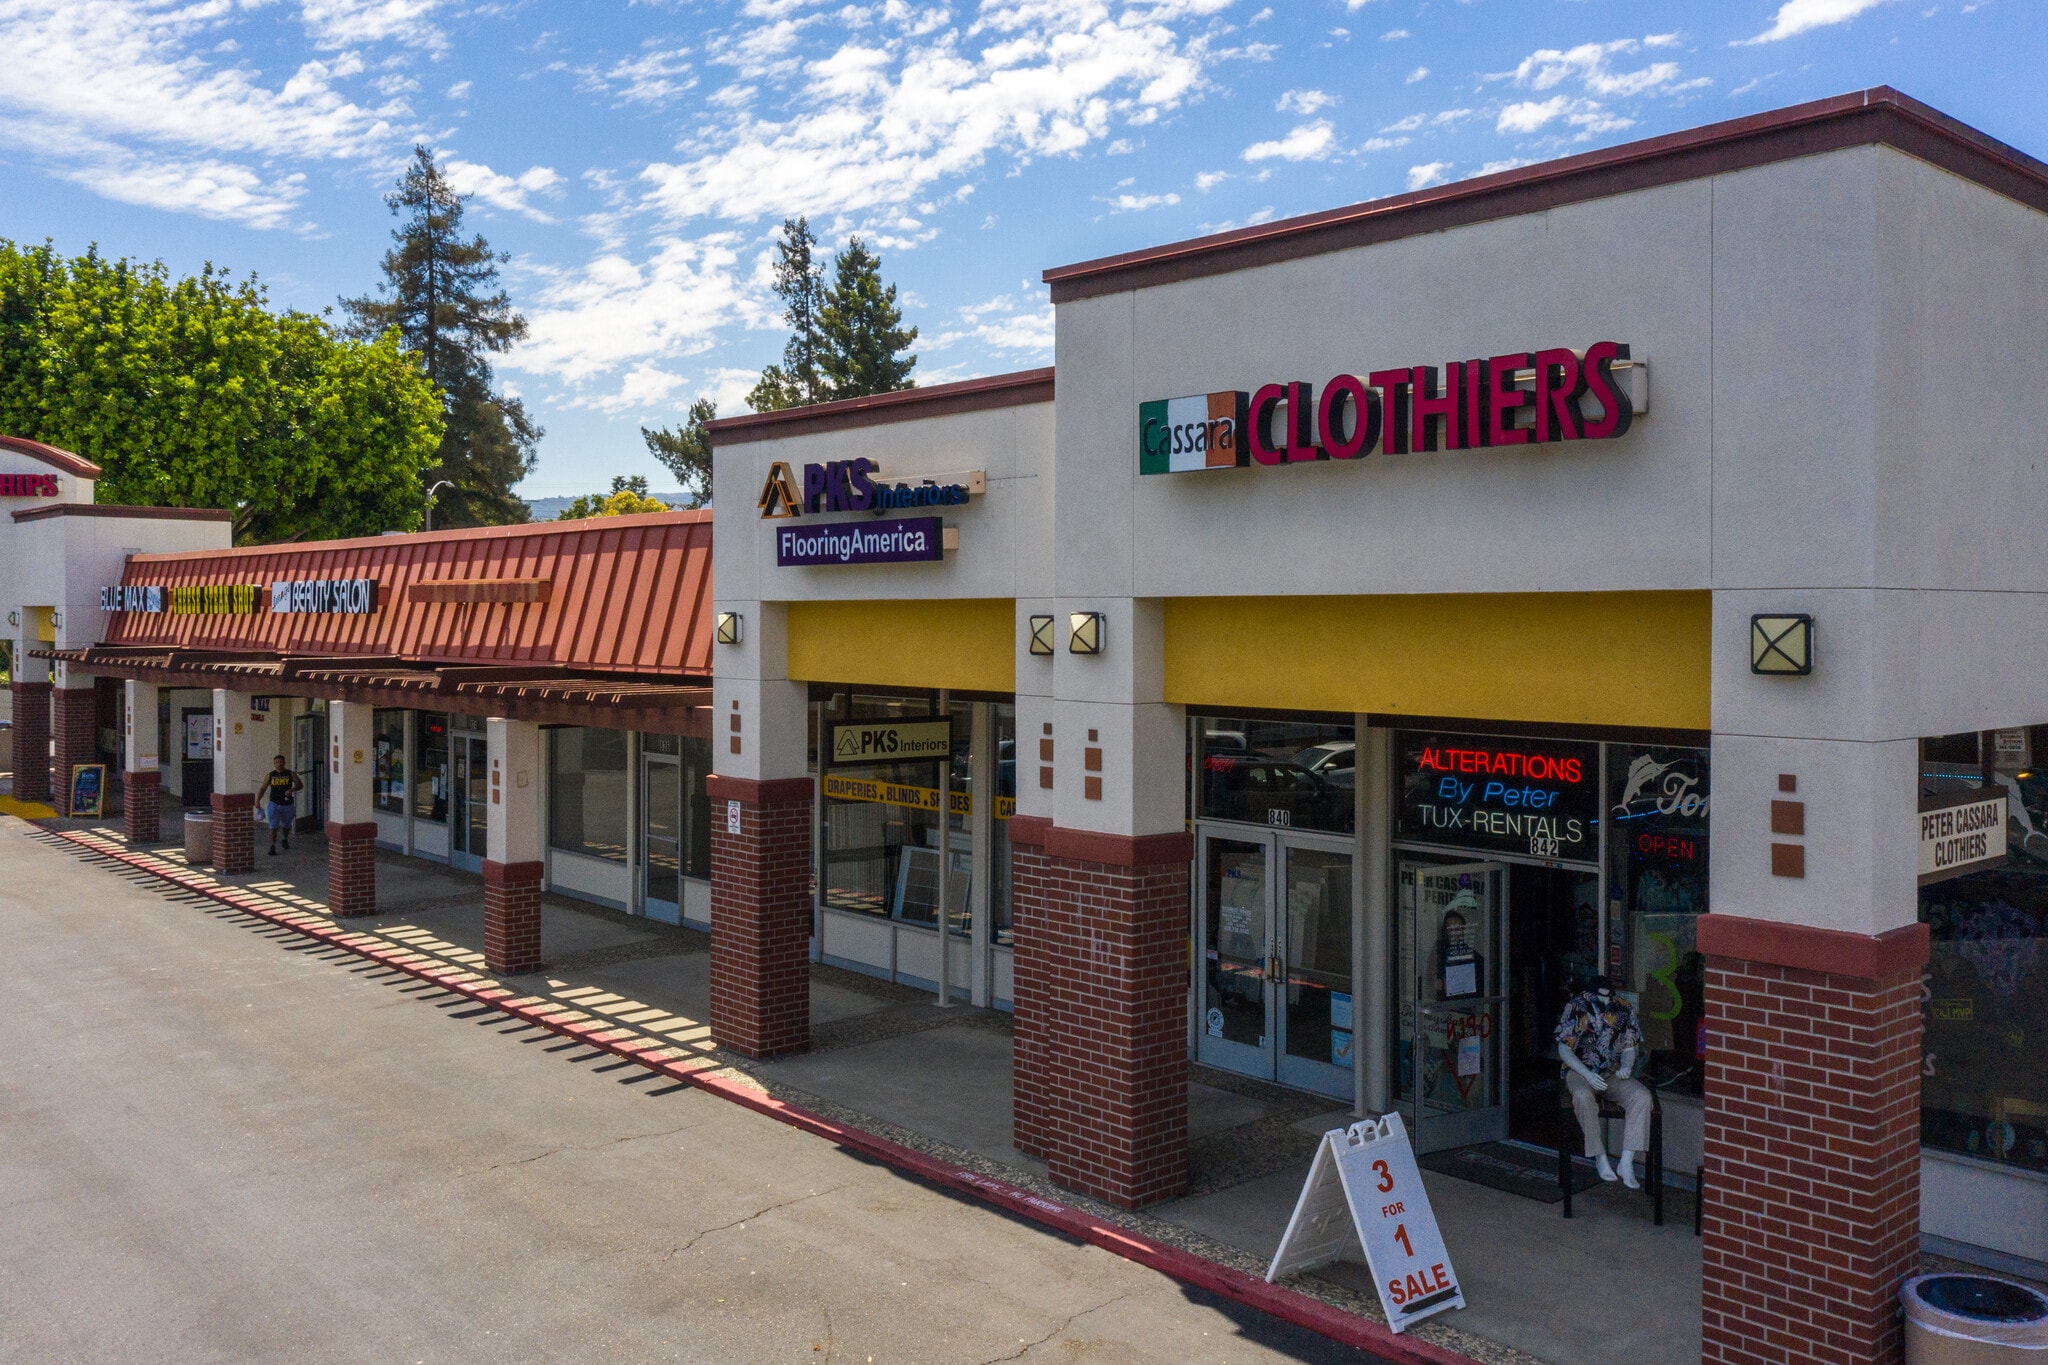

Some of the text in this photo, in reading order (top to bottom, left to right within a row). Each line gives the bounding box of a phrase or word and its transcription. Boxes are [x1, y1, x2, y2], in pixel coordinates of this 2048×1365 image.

[1143, 341, 1632, 466] Cassara CLOTHIERS
[0, 474, 57, 497] HIPS
[804, 457, 967, 513] PKS Interiors
[100, 586, 121, 612] BLUE
[124, 586, 145, 612] MAX
[173, 587, 201, 614] CHEESE
[204, 585, 229, 614] STEAK
[232, 584, 255, 614] SHOP
[292, 580, 331, 613] BEAUTY
[332, 579, 370, 613] SALON
[861, 729, 948, 753] PKS Interiors
[271, 777, 289, 786] ARMY
[1420, 747, 1581, 783] ALTERATIONS
[827, 778, 877, 799] DRAPERIES
[886, 787, 921, 805] BLINDS
[929, 791, 970, 812] SHDES
[1438, 777, 1560, 808] By Peter
[1269, 809, 1290, 825] 840
[1418, 804, 1583, 843] TUX-RENTALS
[1922, 803, 1999, 841] PETER CASSARA
[1531, 837, 1558, 857] 842
[1639, 833, 1694, 860] OPEN
[1935, 832, 1987, 867] CLOTHIERS
[1650, 931, 1683, 1020] 3
[955, 1171, 978, 1181] FIRE
[1009, 1191, 1024, 1199] NO
[1024, 1197, 1065, 1214] PARKING
[1371, 1159, 1394, 1193] 3
[1381, 1201, 1406, 1218] FOR
[1393, 1223, 1414, 1258] 1
[1388, 1263, 1451, 1305] SALE
